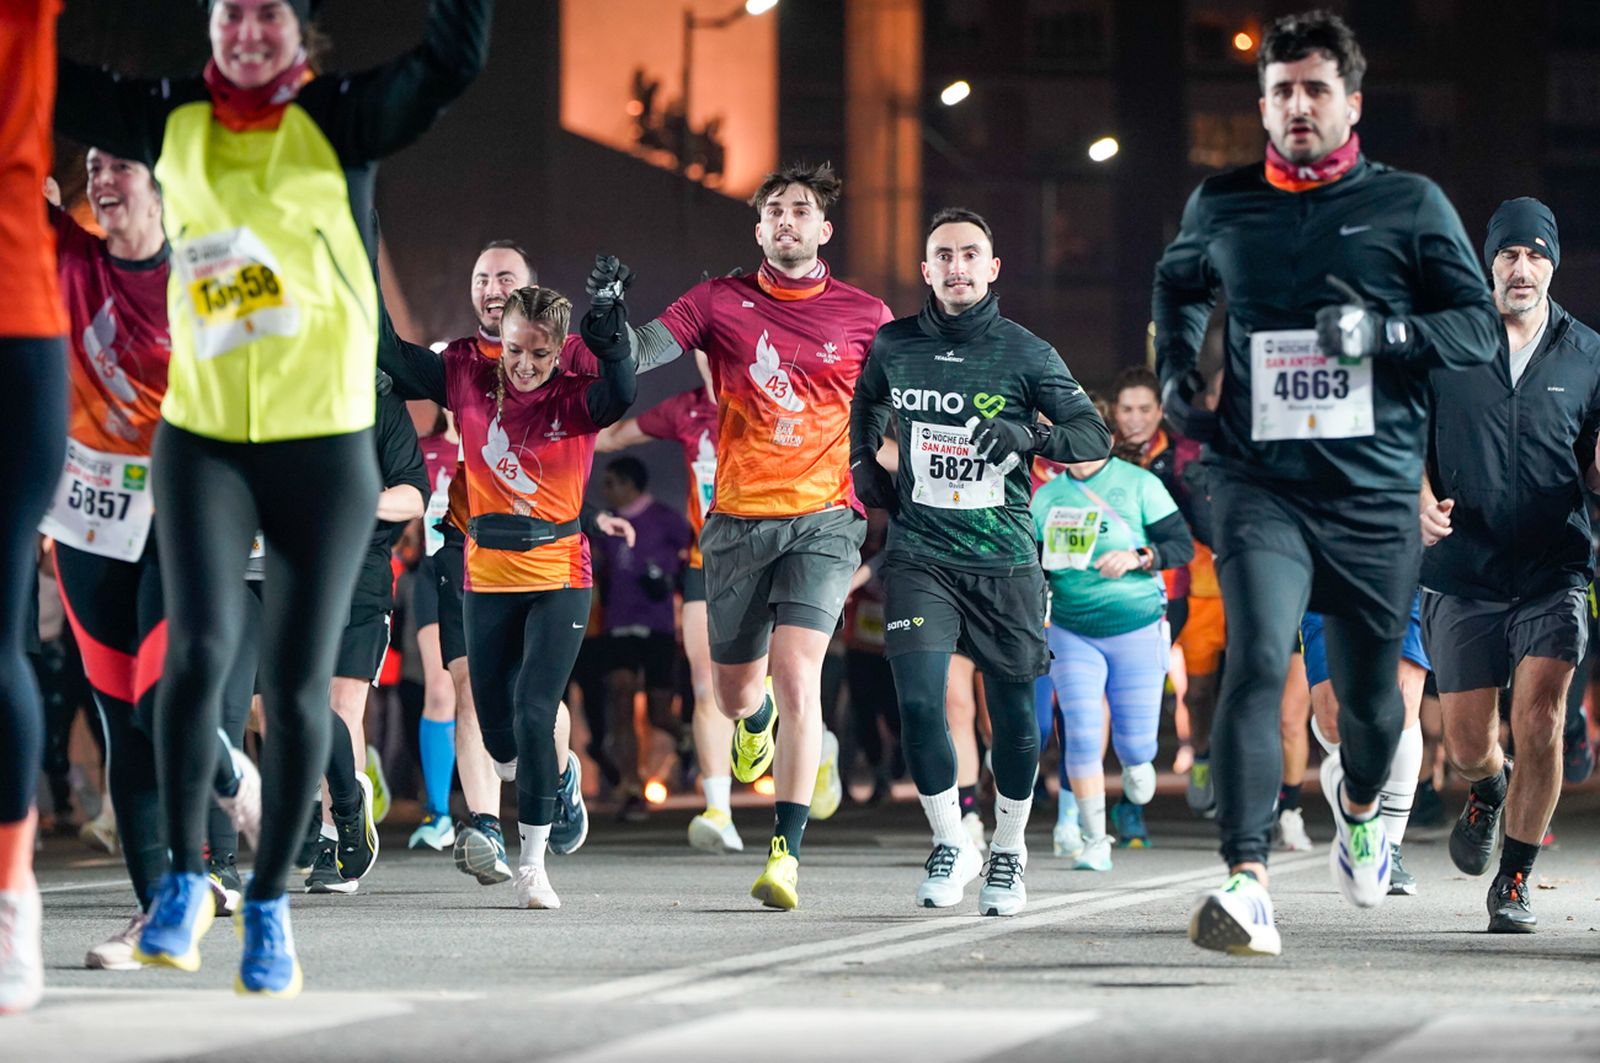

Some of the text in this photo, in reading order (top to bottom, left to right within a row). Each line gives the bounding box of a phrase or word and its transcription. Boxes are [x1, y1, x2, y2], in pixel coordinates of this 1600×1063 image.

[765, 375, 789, 399] 43
[1273, 369, 1350, 401] 4663
[891, 387, 965, 415] sano
[921, 442, 939, 452] SAN
[932, 434, 957, 444] NOCHE
[958, 436, 969, 446] DE
[496, 457, 519, 480] 43
[929, 454, 986, 482] 5827
[68, 479, 132, 521] 5857
[887, 619, 911, 631] sano
